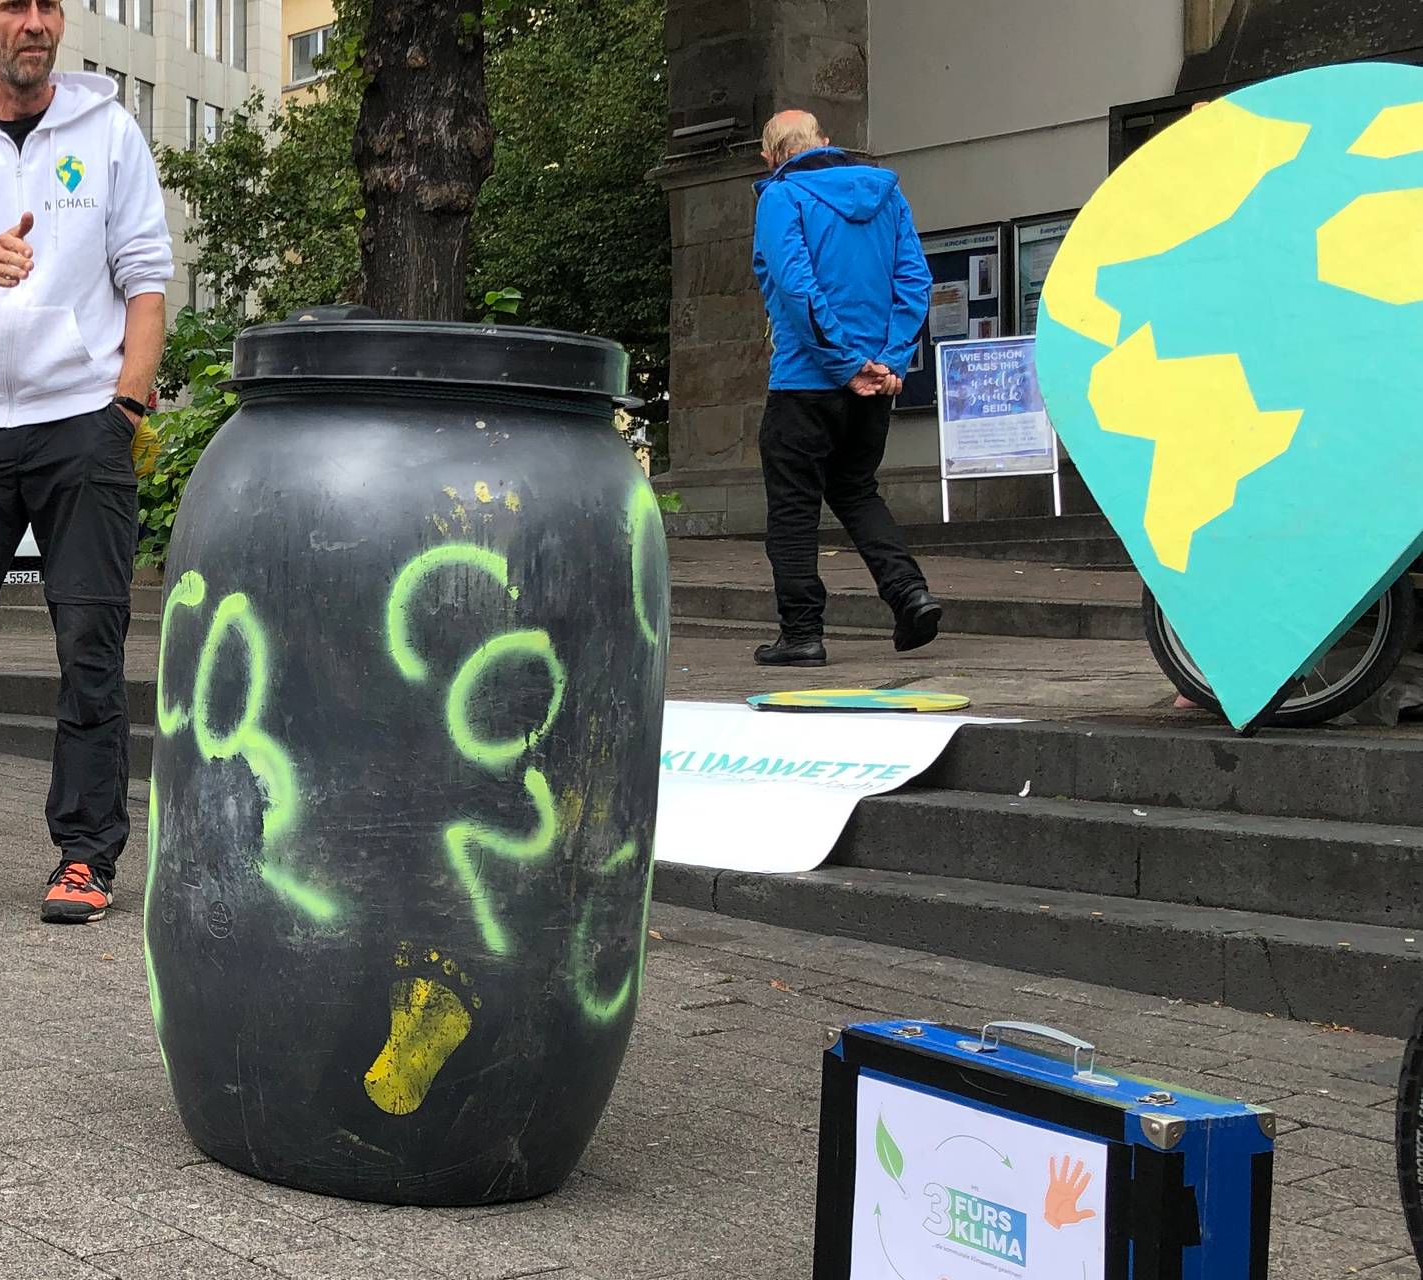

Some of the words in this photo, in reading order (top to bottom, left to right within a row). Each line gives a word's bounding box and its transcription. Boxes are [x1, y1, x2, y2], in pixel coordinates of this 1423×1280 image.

[960, 352, 981, 362] WIE
[983, 350, 1026, 361] SCHÖN,
[968, 362, 997, 372] DASS
[1000, 361, 1020, 370] IHR
[660, 750, 910, 780] KLIMAWETTE
[922, 1182, 952, 1237] 3
[955, 1195, 1012, 1232] FÜRS
[955, 1217, 1024, 1261] KLIMA
